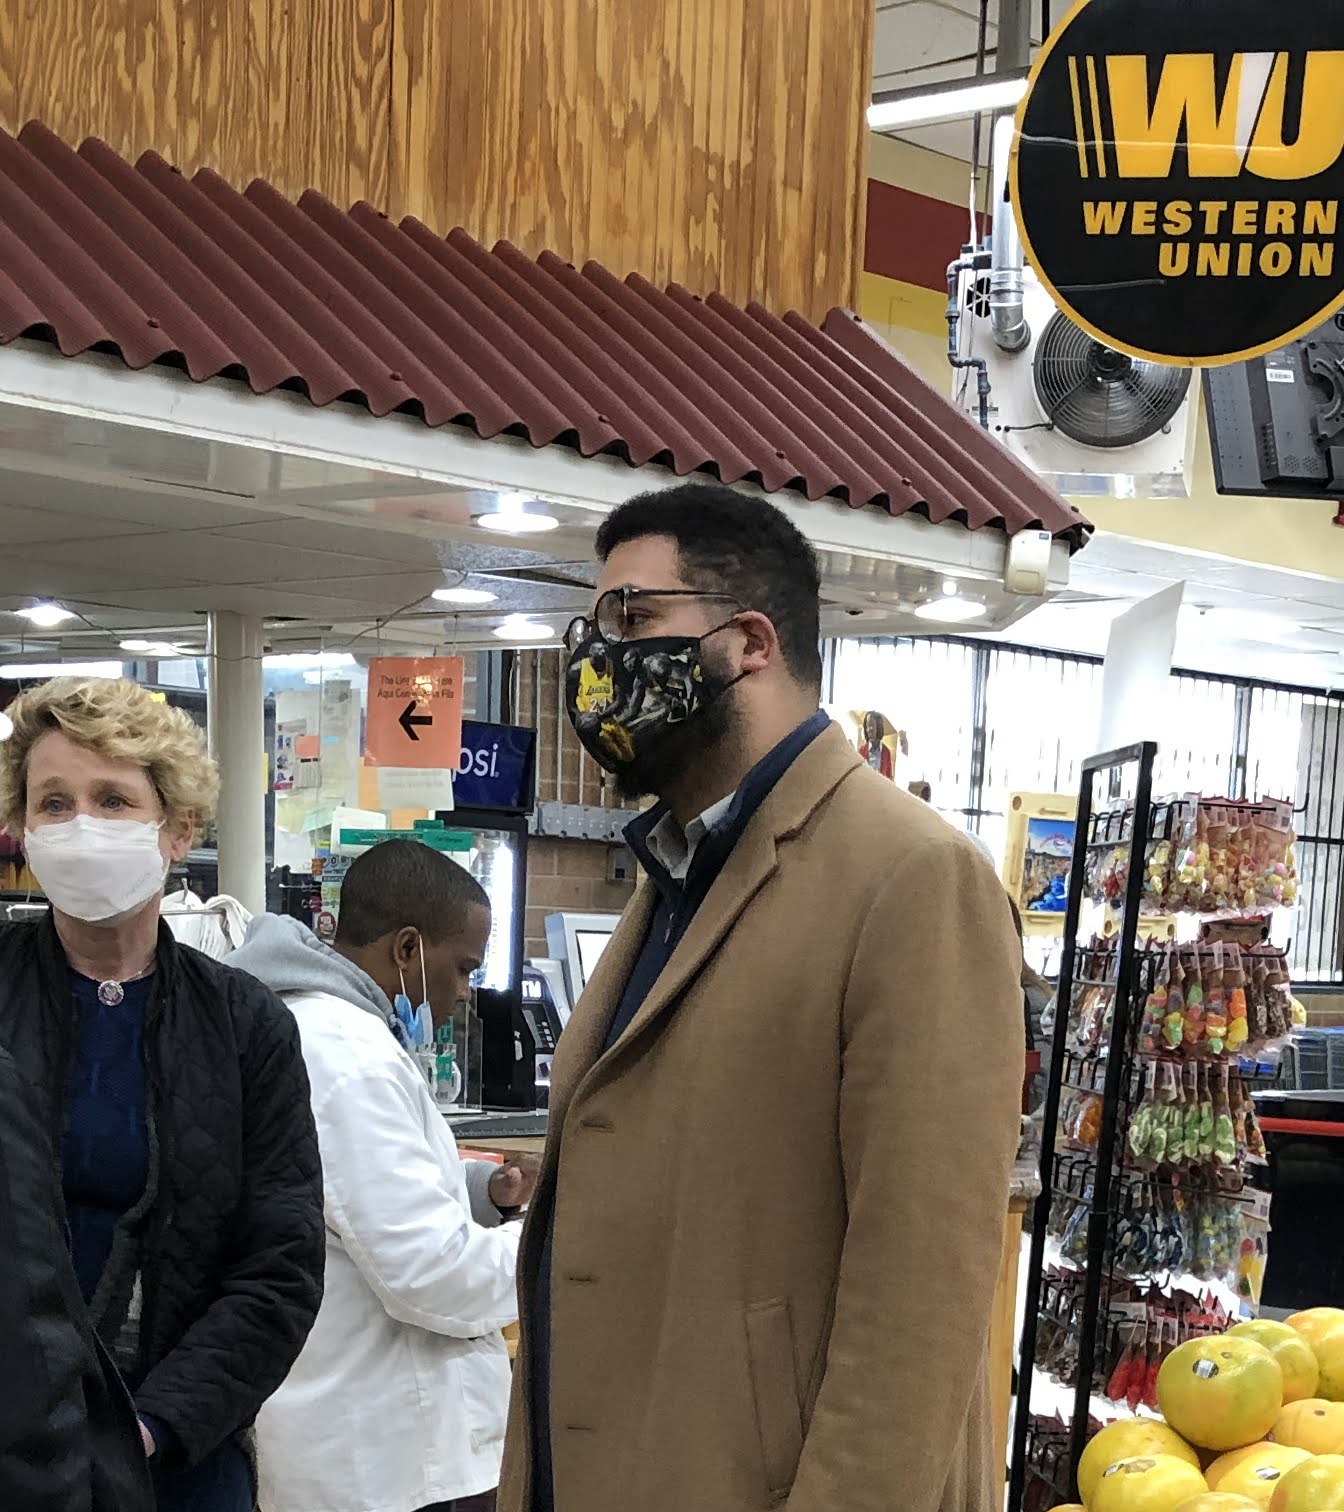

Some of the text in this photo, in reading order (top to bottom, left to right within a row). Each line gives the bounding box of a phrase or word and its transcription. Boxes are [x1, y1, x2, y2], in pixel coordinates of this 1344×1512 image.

[1083, 200, 1339, 235] WESTERN
[1158, 241, 1335, 277] UNION
[452, 743, 498, 783] psi
[522, 980, 541, 998] TM
